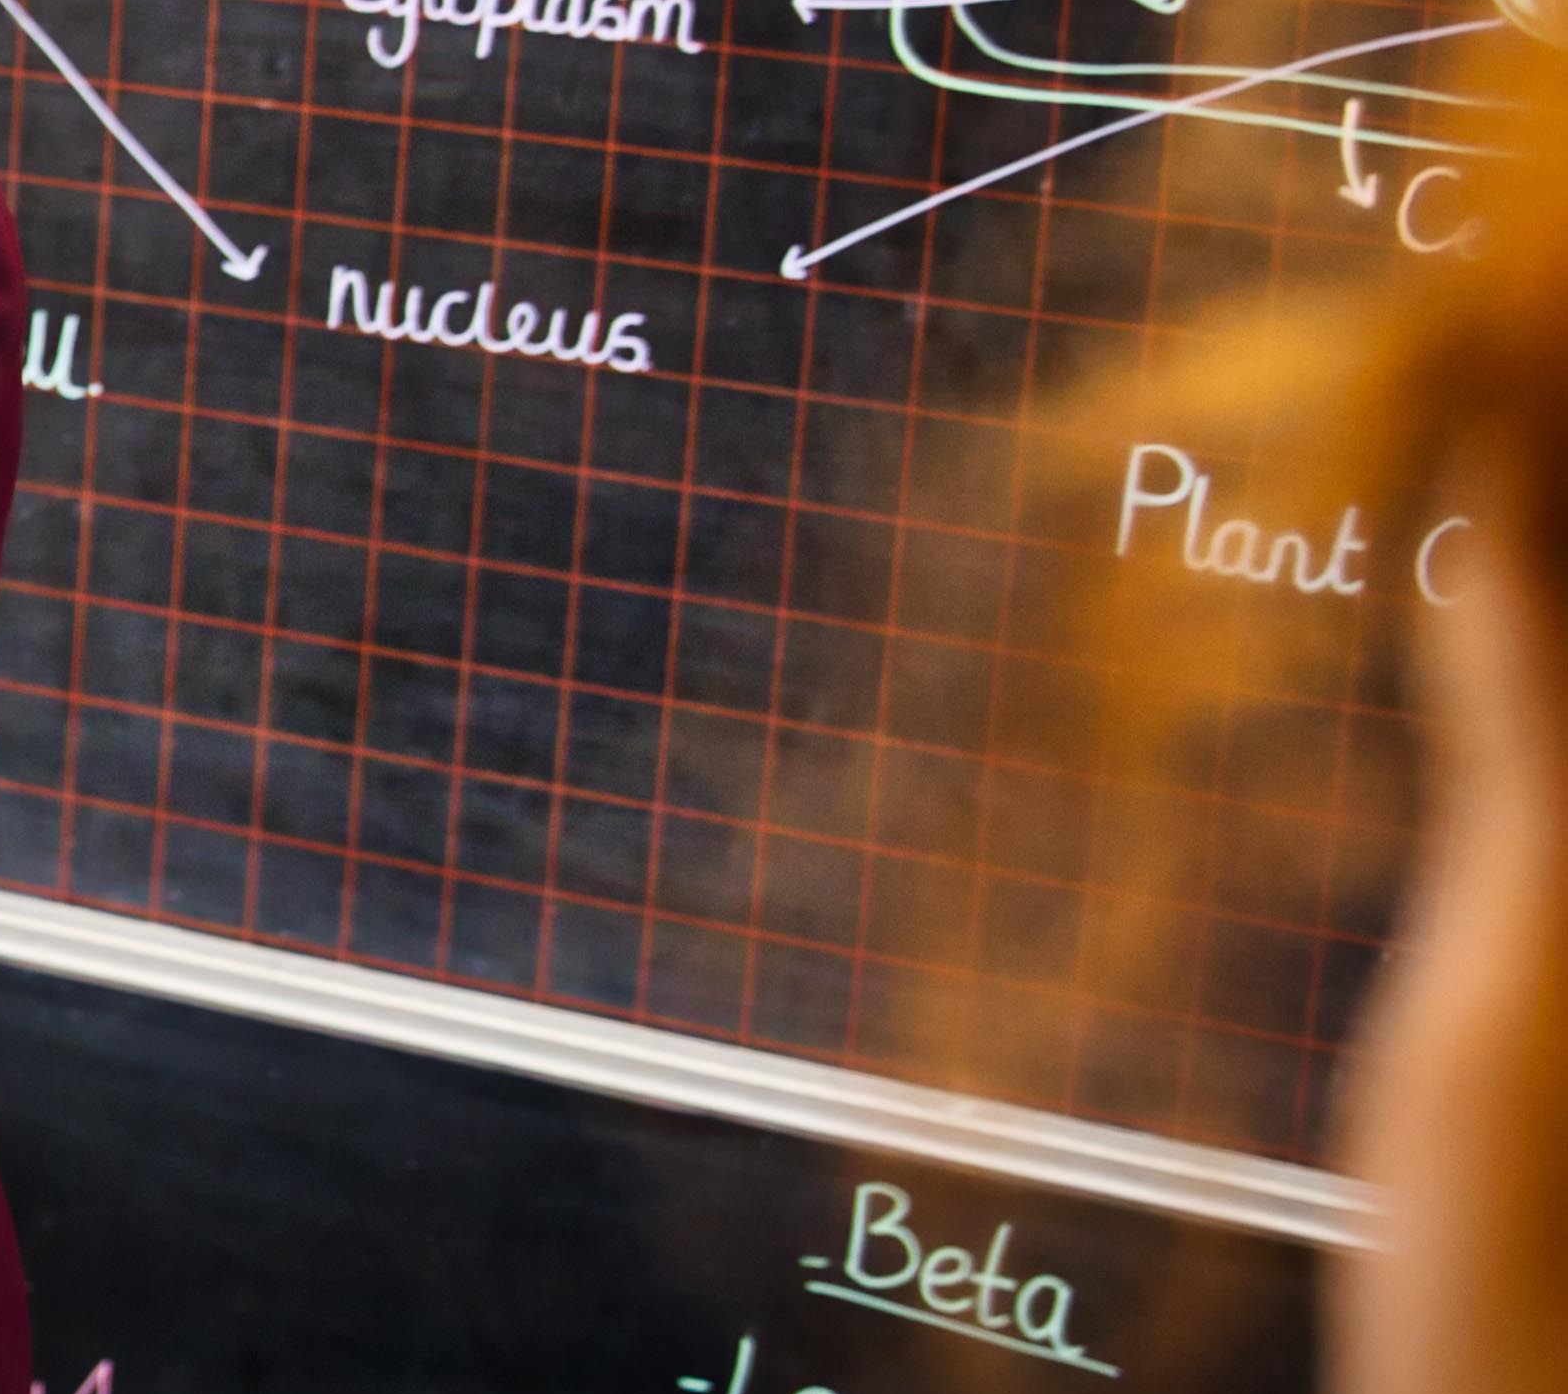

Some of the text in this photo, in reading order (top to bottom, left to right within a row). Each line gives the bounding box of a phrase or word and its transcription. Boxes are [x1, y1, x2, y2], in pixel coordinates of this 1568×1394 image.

[20, 263, 655, 400] ll. nucleus
[1117, 442, 1366, 598] Plant
